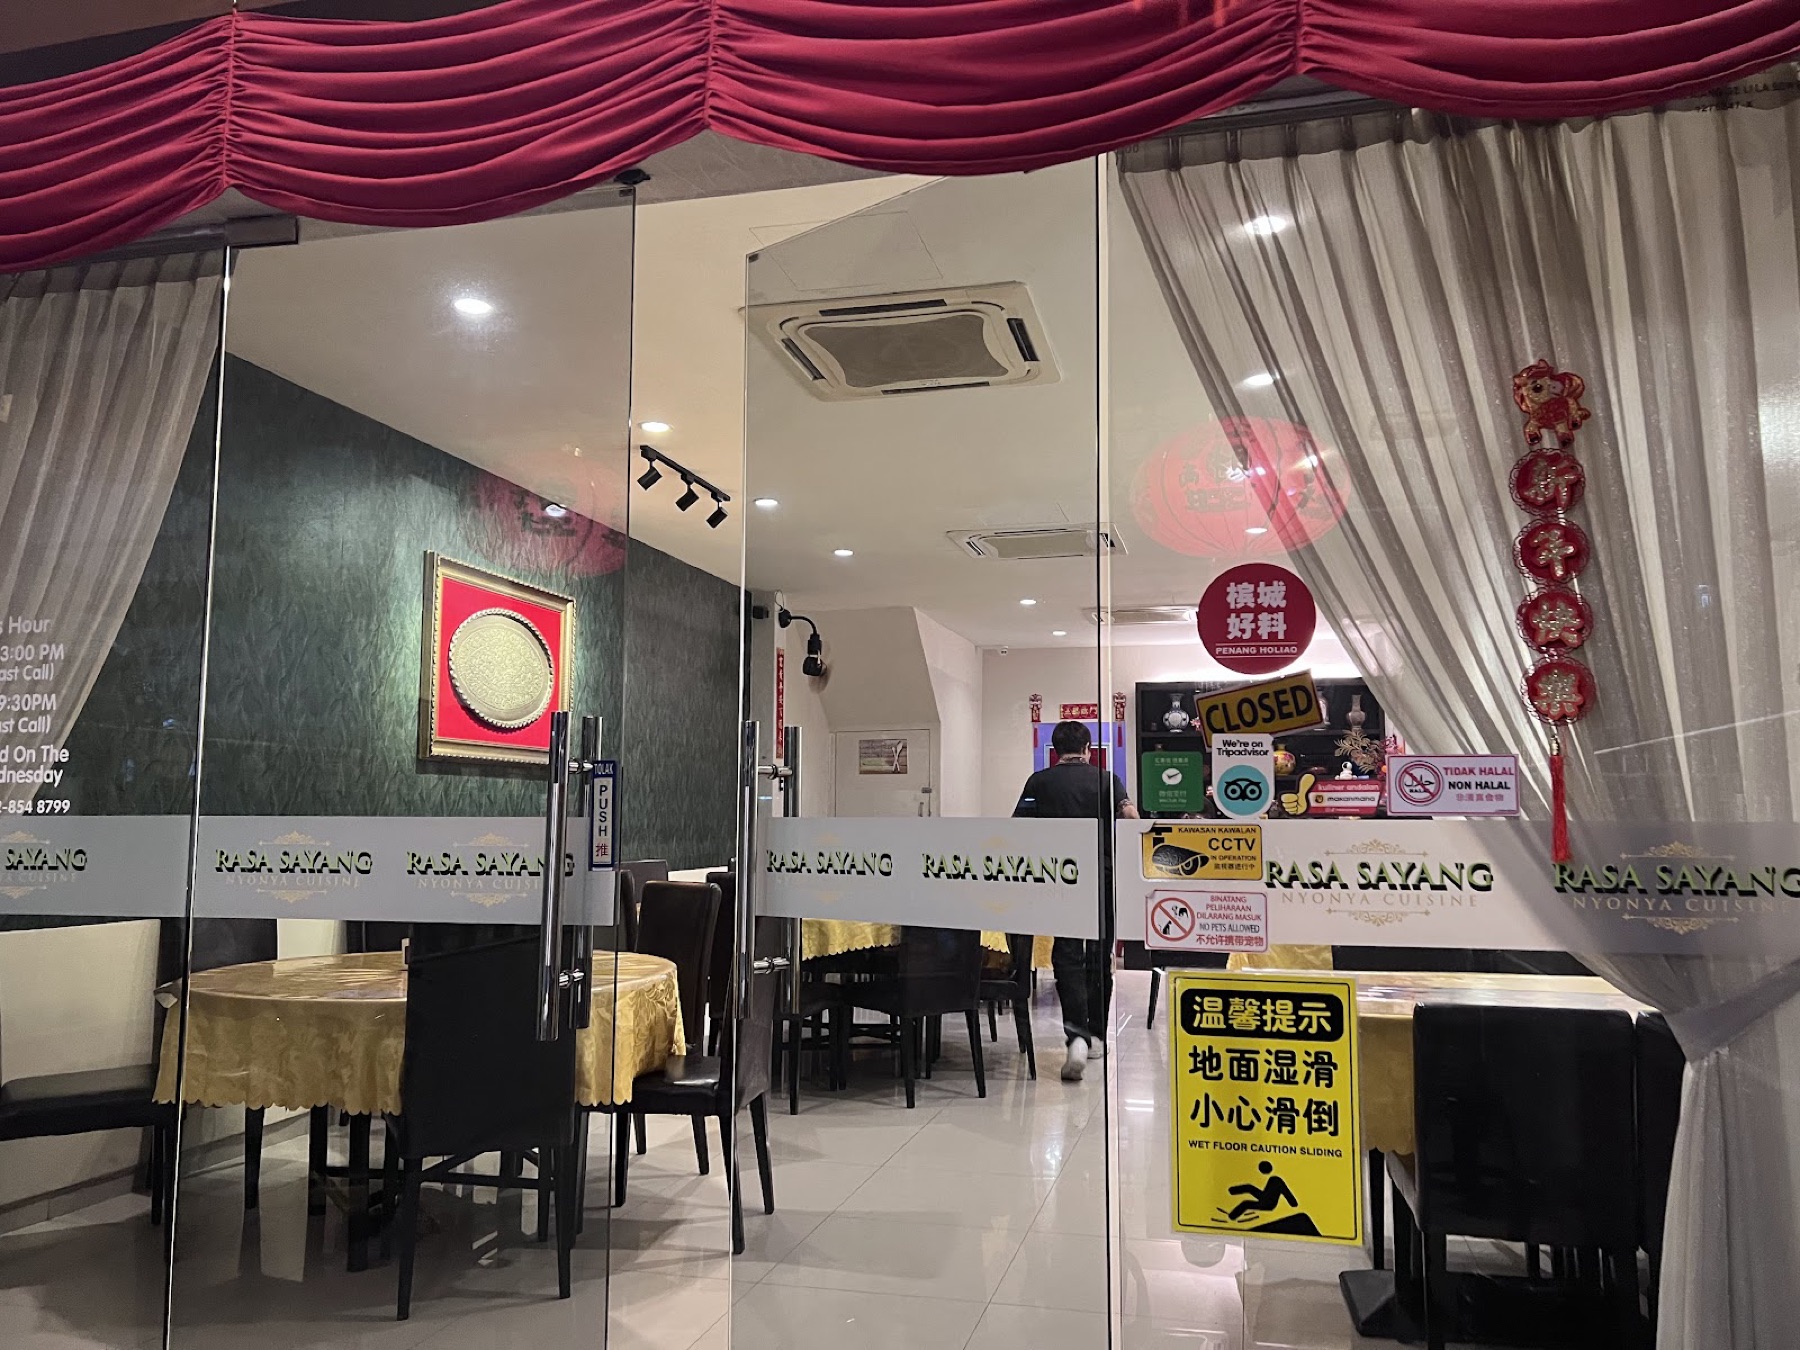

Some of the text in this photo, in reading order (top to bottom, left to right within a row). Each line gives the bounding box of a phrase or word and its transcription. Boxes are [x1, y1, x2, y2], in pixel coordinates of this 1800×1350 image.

[8, 616, 51, 634] Hour
[1226, 612, 1287, 640] 好料
[0, 643, 65, 661] 3:00 PM
[1216, 646, 1298, 655] PENANG HOLIAO
[22, 663, 55, 681] Call)
[0, 693, 57, 711] 9:30PM
[1205, 685, 1313, 733] CLOSED
[18, 714, 51, 734] Call)
[1222, 739, 1250, 748] We're
[13, 745, 36, 763] On
[40, 744, 70, 763] The
[1217, 748, 1270, 758] Tripadvisor
[594, 763, 614, 775] TOLAK
[1443, 767, 1514, 776] TIDAK HALAL
[1448, 781, 1511, 790] NON HALAL
[36, 800, 71, 814] 8799
[598, 784, 608, 837] PUSH
[595, 843, 609, 857] 推
[1208, 837, 1256, 851] CCTV
[5, 848, 87, 871] SAYANG
[215, 849, 373, 875] RASA SAYANG
[407, 851, 468, 876] RASA
[766, 850, 893, 877] RASA SAYANG
[921, 853, 1079, 885] RASA SAYANG
[1264, 860, 1494, 892] RASA SAYANG
[417, 877, 483, 889] NYONYA
[1552, 863, 1800, 899] RASA SAYANG
[1206, 903, 1252, 912] PELIHARAAN
[1210, 895, 1247, 903] BINATANG
[1282, 891, 1478, 907] NYONYA CUISINE
[1573, 897, 1672, 911] NYONYA
[1196, 911, 1233, 920] DILARANG
[1199, 923, 1260, 933] NO PETS ALLOWED
[1192, 995, 1332, 1034] 温馨提示
[1188, 1045, 1339, 1089] 地面湿滑
[1190, 1092, 1340, 1137] 小心滑倒
[1188, 1140, 1343, 1158] WET FLOOR CAUTION SLIDING
